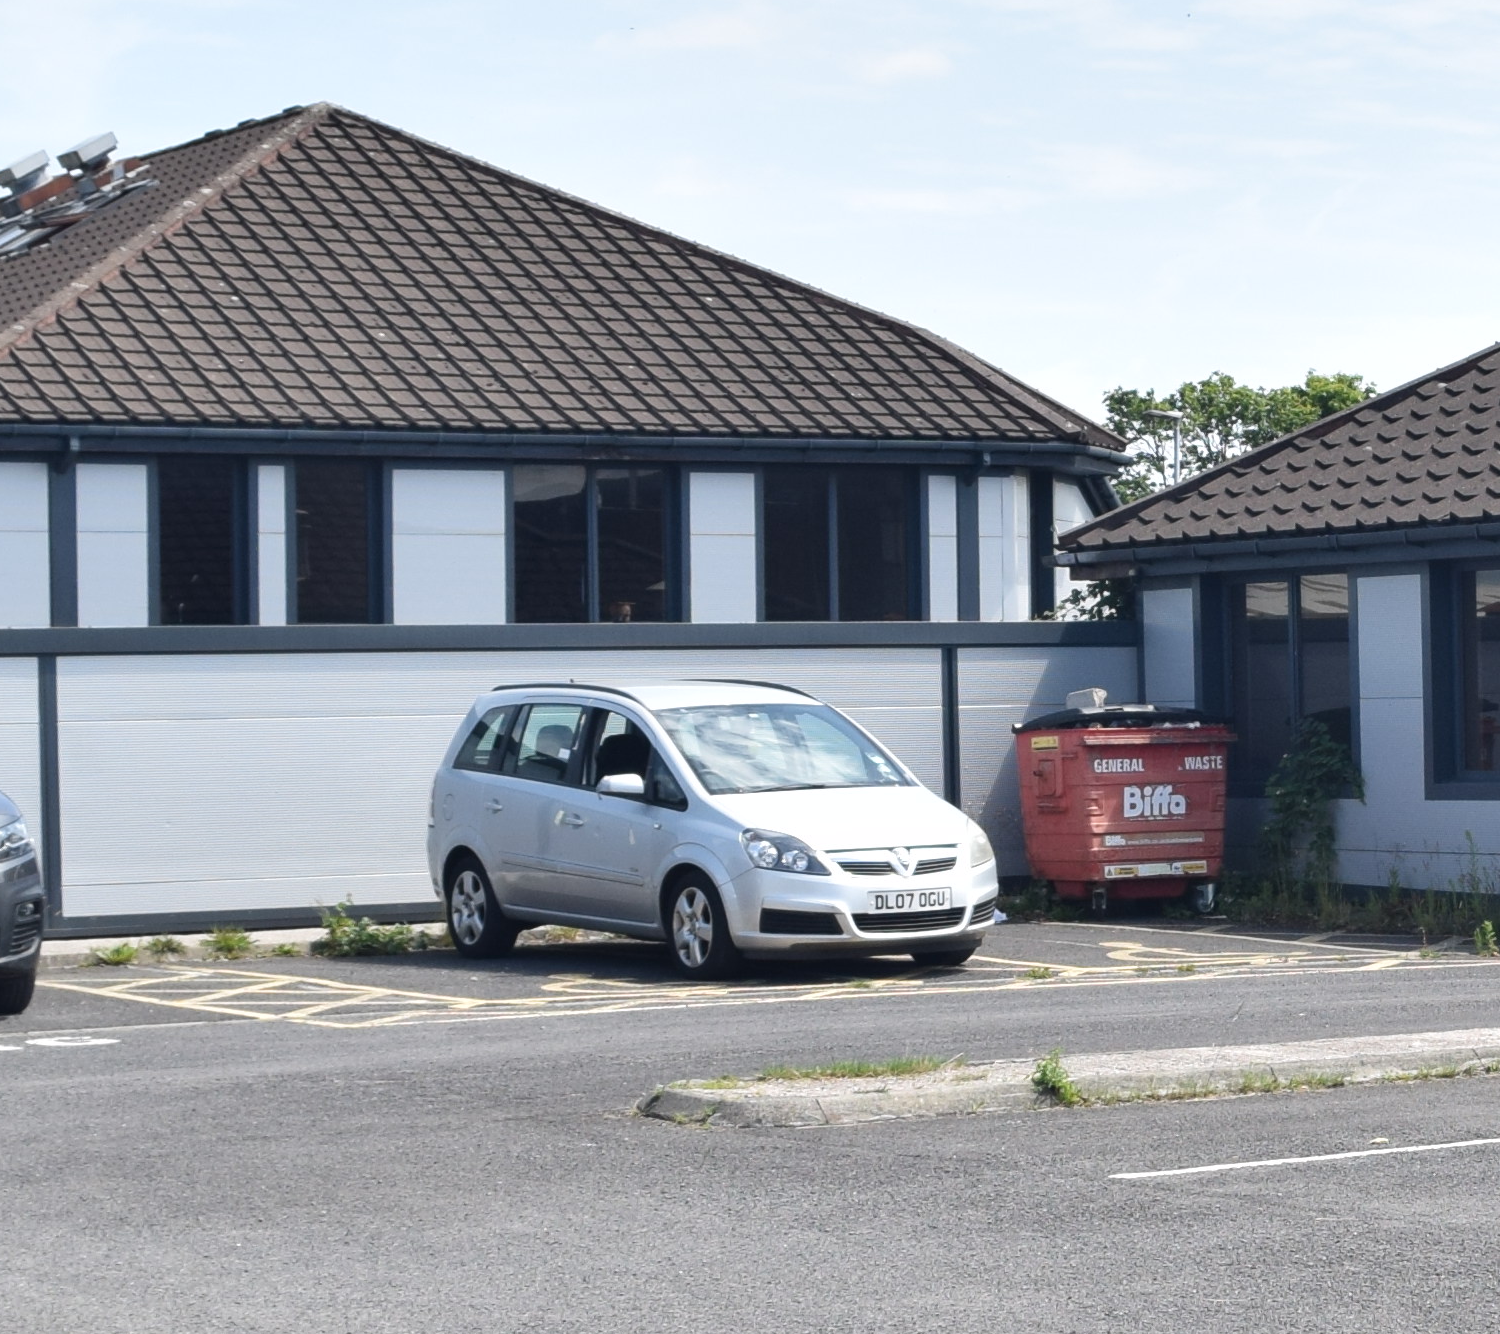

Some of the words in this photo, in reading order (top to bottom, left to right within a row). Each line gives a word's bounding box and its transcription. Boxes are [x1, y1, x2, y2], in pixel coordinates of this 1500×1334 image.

[1093, 758, 1145, 773] GENERAL
[1184, 756, 1223, 771] WASTE
[1123, 785, 1186, 819] Biffa
[874, 893, 915, 910] DL07
[919, 891, 946, 908] OGU
